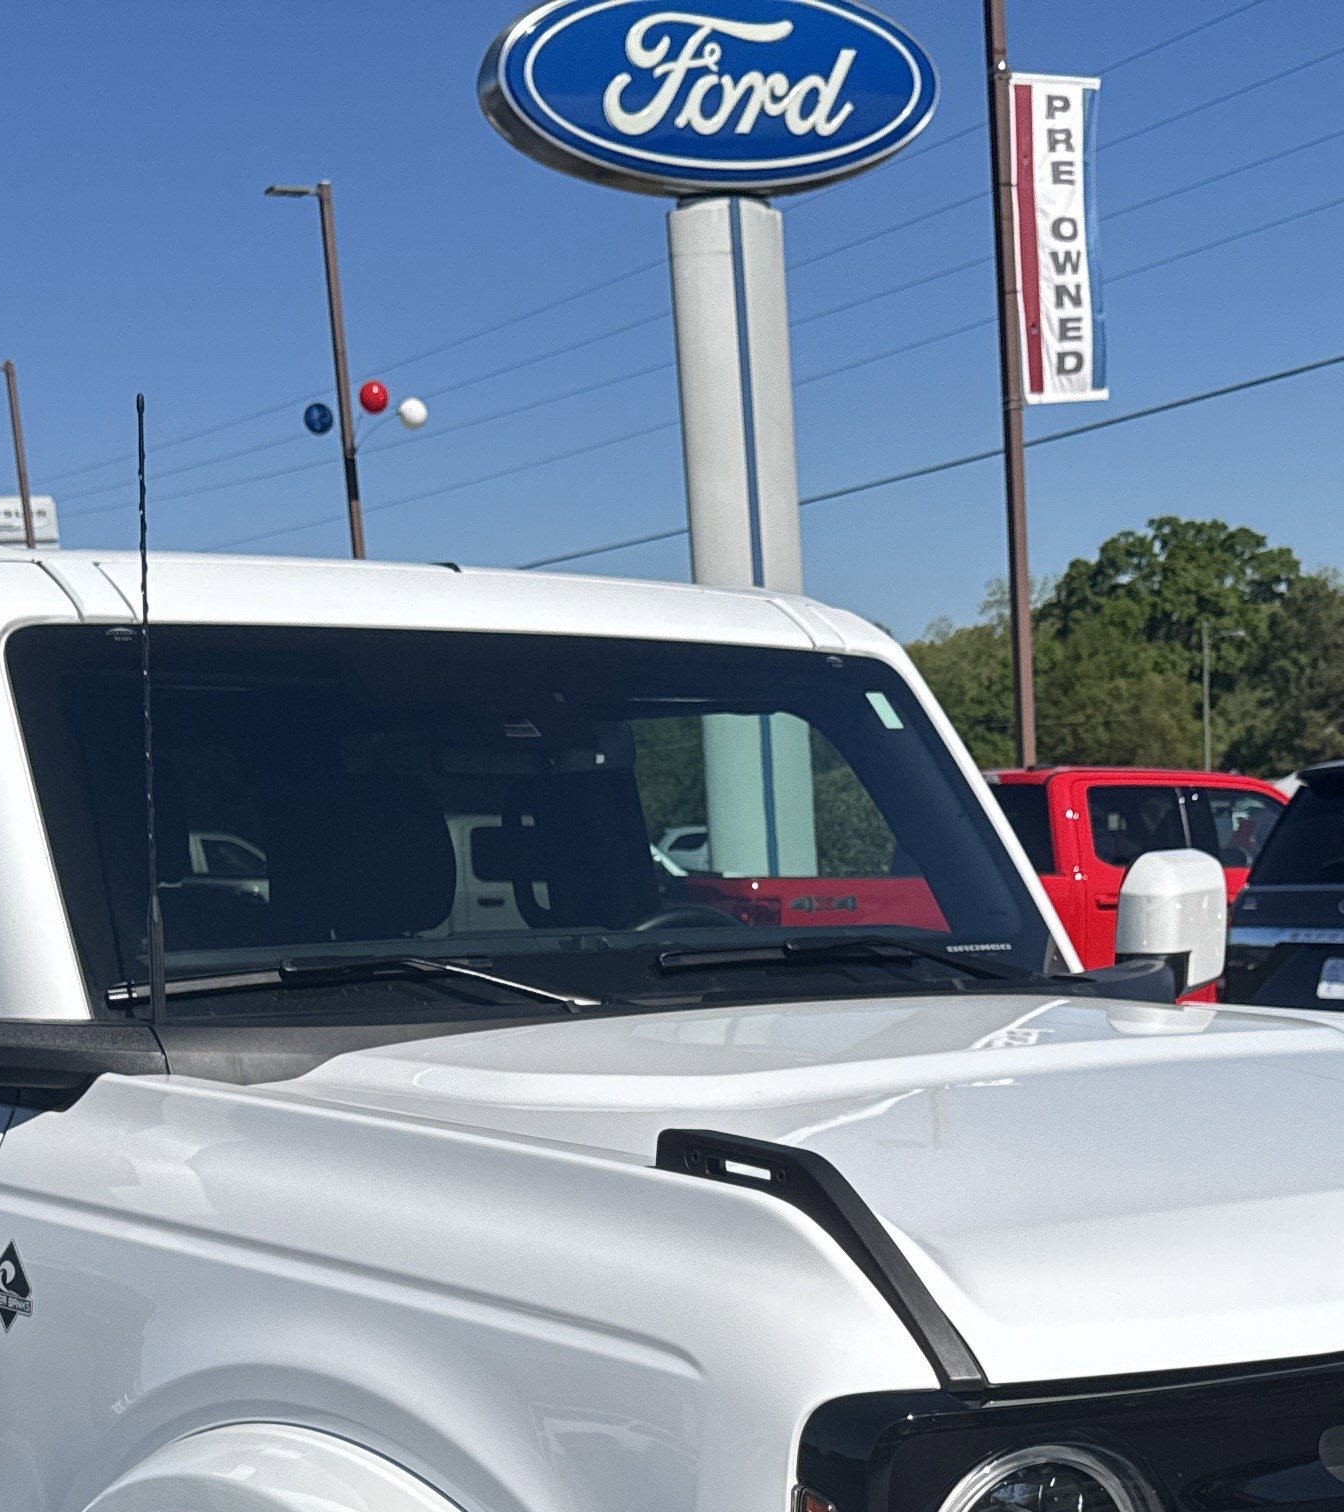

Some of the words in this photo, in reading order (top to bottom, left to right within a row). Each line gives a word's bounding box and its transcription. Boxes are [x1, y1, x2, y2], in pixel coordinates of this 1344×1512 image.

[603, 12, 857, 136] Ford
[1045, 94, 1076, 187] PRE
[1050, 217, 1084, 375] OWNED
